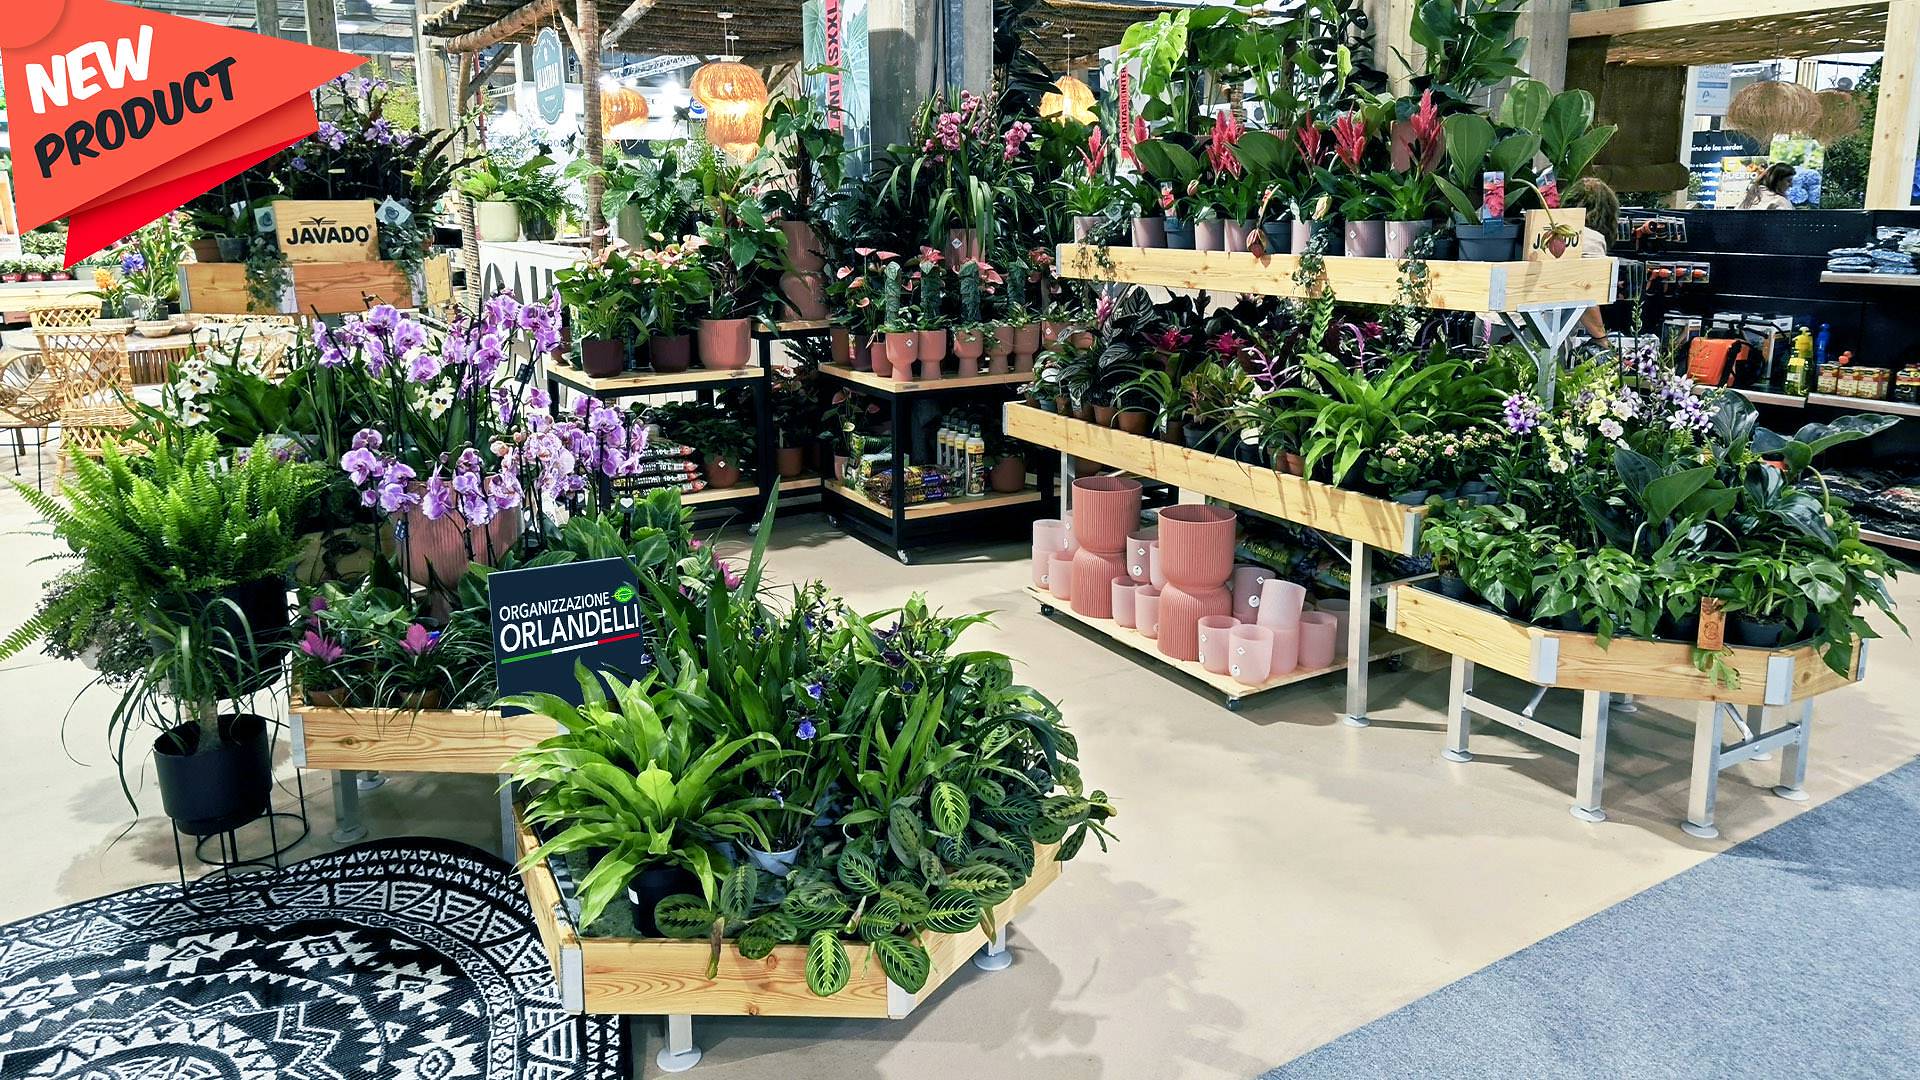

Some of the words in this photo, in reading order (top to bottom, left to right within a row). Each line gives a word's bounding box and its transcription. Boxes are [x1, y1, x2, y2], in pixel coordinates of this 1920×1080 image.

[286, 225, 370, 245] JAVADO
[499, 592, 610, 622] ORGANIZZAZIONE
[499, 603, 640, 652] ORLANDELLI
